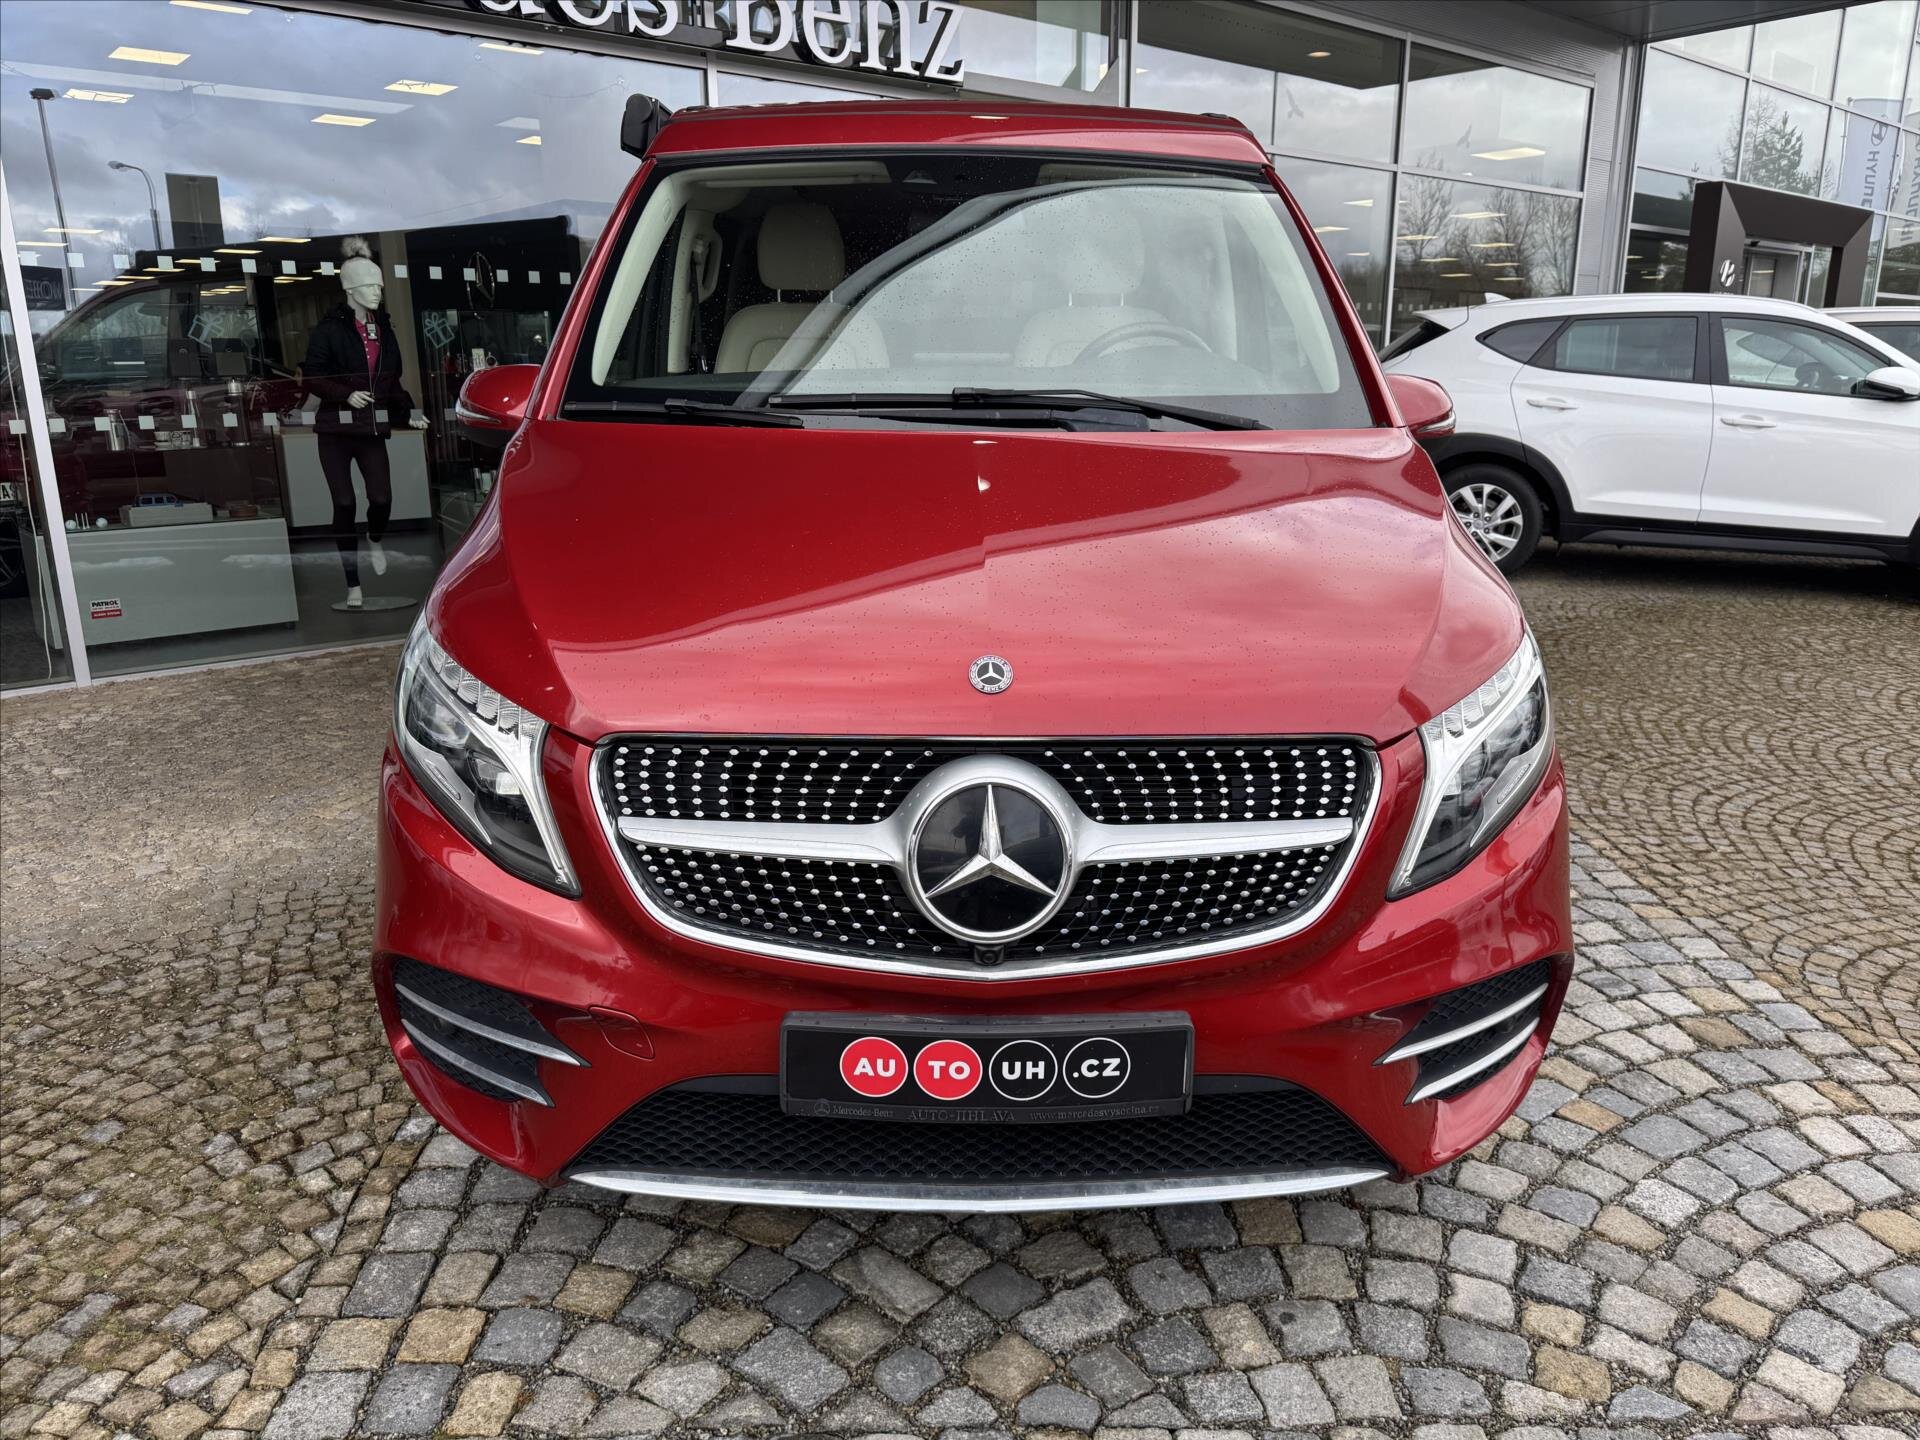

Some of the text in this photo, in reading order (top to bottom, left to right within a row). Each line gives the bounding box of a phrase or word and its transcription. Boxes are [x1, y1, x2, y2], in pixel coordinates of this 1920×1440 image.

[853, 1057, 1121, 1080] AU TO UH .CZ
[832, 1102, 894, 1118] Mercedes-Benz
